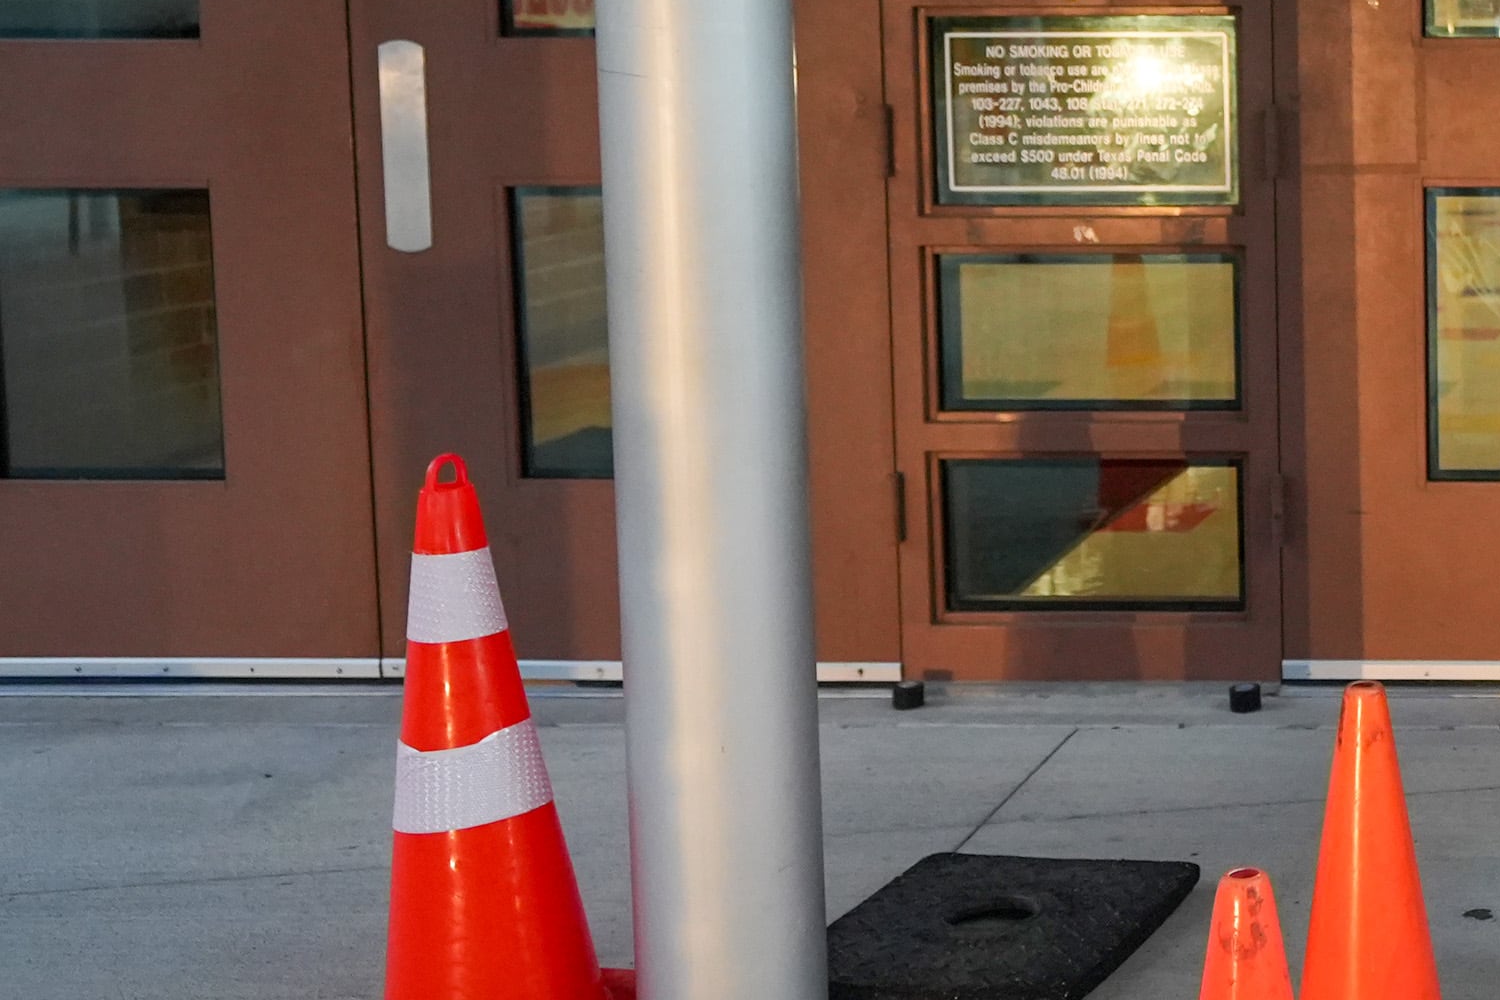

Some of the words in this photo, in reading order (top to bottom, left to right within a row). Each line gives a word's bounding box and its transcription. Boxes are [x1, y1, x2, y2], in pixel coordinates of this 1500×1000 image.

[986, 45, 1005, 58] NO
[1010, 45, 1070, 58] SMOKING
[1073, 45, 1092, 58] OR
[1096, 45, 1155, 58] TOBAO
[1160, 45, 1184, 58] USE
[954, 62, 1000, 78] Smoking
[1004, 66, 1016, 76] or
[1020, 64, 1064, 76] tobacco
[1068, 66, 1087, 76] use
[1091, 66, 1109, 76] are
[958, 80, 1008, 95] premises
[1011, 80, 1026, 96] by
[1029, 80, 1046, 93] the
[972, 98, 1025, 112] 103-227,
[1030, 98, 1062, 112] 1043,
[1067, 98, 1088, 110] 108
[1026, 115, 1082, 128] violations
[1088, 118, 1108, 127] are
[1112, 115, 1178, 130] punishable
[1182, 118, 1197, 127] as
[970, 132, 1004, 145] Class
[1008, 132, 1018, 145] C
[1022, 132, 1110, 145] misdemeanors
[1116, 133, 1128, 148] by
[1170, 132, 1190, 145] not
[971, 150, 1016, 163] exceed
[1020, 150, 1054, 163] $500
[1058, 150, 1094, 163] under
[1098, 150, 1132, 163] Texas
[1137, 150, 1170, 163] Penal
[1175, 150, 1208, 163] Code
[1051, 167, 1085, 180] 48.01
[1090, 167, 1128, 180] (1994)
